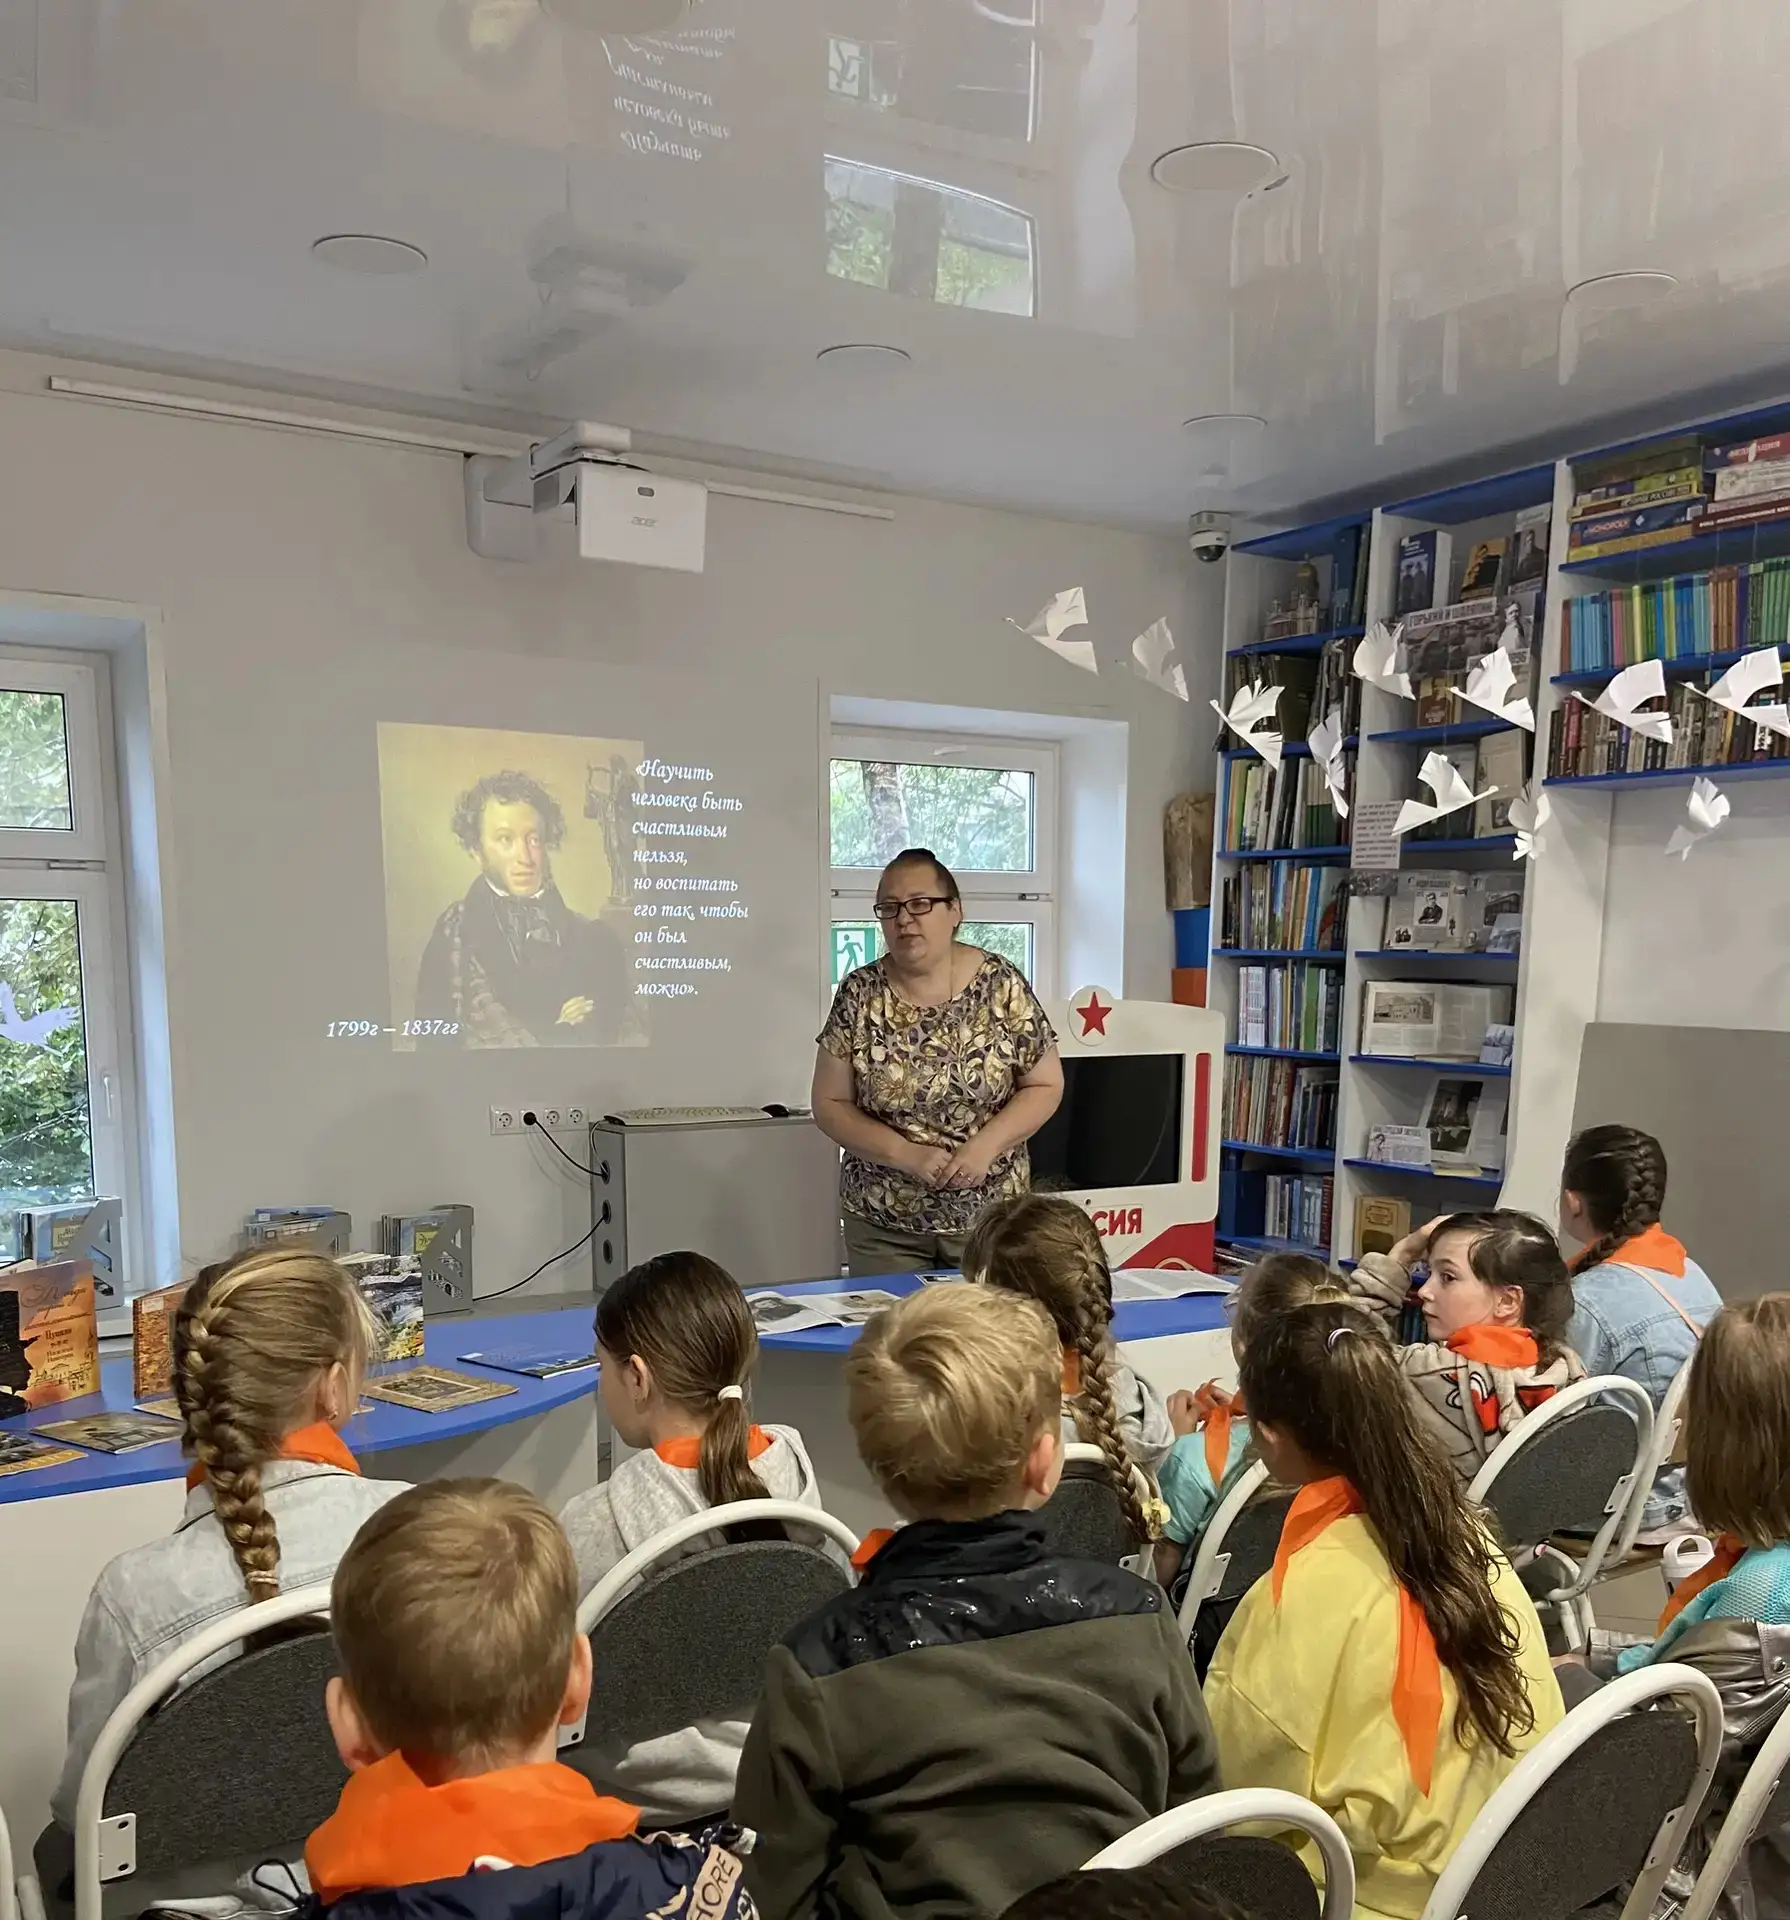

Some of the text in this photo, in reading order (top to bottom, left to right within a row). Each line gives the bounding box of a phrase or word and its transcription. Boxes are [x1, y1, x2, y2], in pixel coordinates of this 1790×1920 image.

[635, 759, 714, 784] «Научить
[631, 791, 743, 813] человека быть
[632, 821, 727, 838] счастливым
[633, 850, 688, 867] нельзя,
[633, 877, 739, 892] но воспитать
[633, 901, 749, 921] его так, чтобы
[634, 926, 688, 944] он был
[634, 957, 732, 972] счастливым,
[634, 983, 699, 999] можно».
[326, 1020, 379, 1037] 1799г
[401, 1019, 459, 1036] 1837гг
[1091, 1207, 1143, 1237] СИЯ
